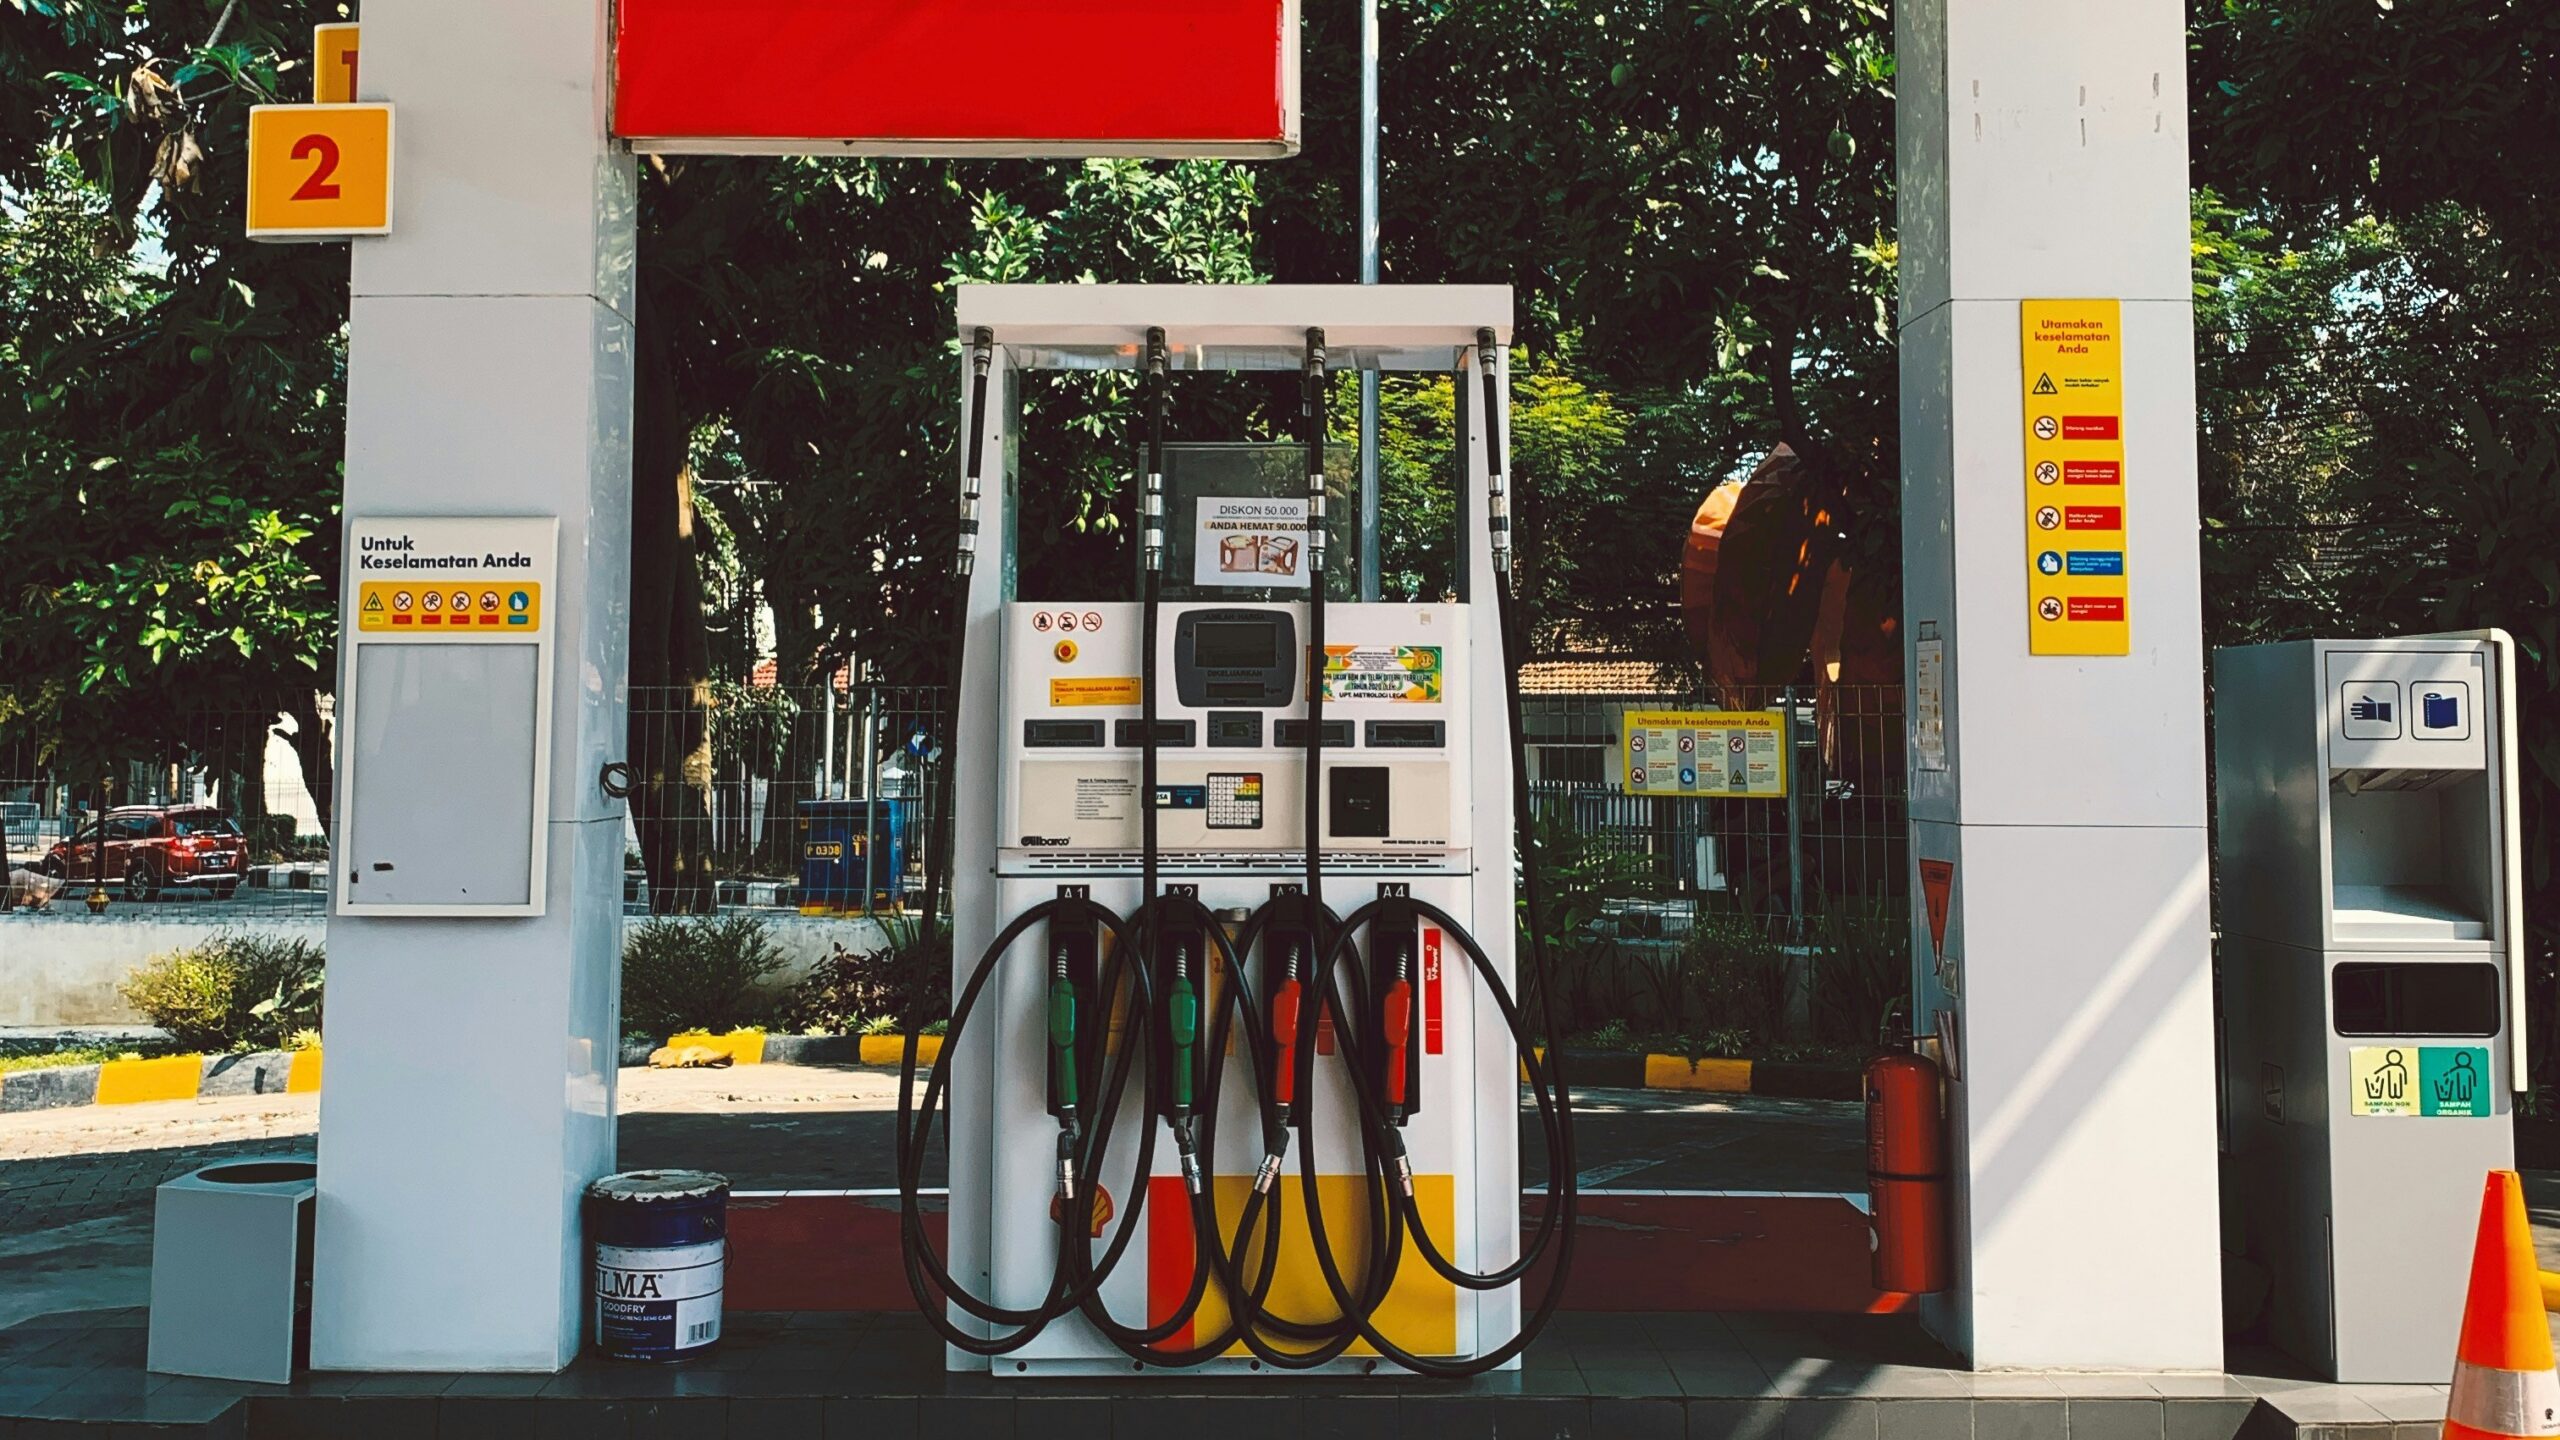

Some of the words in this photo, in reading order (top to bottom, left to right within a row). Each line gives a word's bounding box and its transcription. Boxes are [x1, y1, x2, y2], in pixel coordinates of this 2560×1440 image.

[289, 133, 341, 200] 2
[2041, 319, 2103, 329] Utamakan
[2034, 332, 2110, 342] keselamatan
[2057, 345, 2089, 354] Anda
[1220, 505, 1262, 515] DISKON
[1264, 506, 1298, 516] 50.000
[1210, 522, 1238, 530] ANDA
[1240, 522, 1275, 531] HEMAT
[1276, 523, 1307, 531] 90.000
[361, 536, 415, 551] Untuk
[361, 554, 478, 569] Keselamatan
[483, 552, 532, 568] Anda
[1637, 717, 1682, 726] Utamakan
[1685, 718, 1742, 726] keselamatan
[1021, 836, 1069, 846] Gilbarco
[1382, 885, 1406, 899] A4
